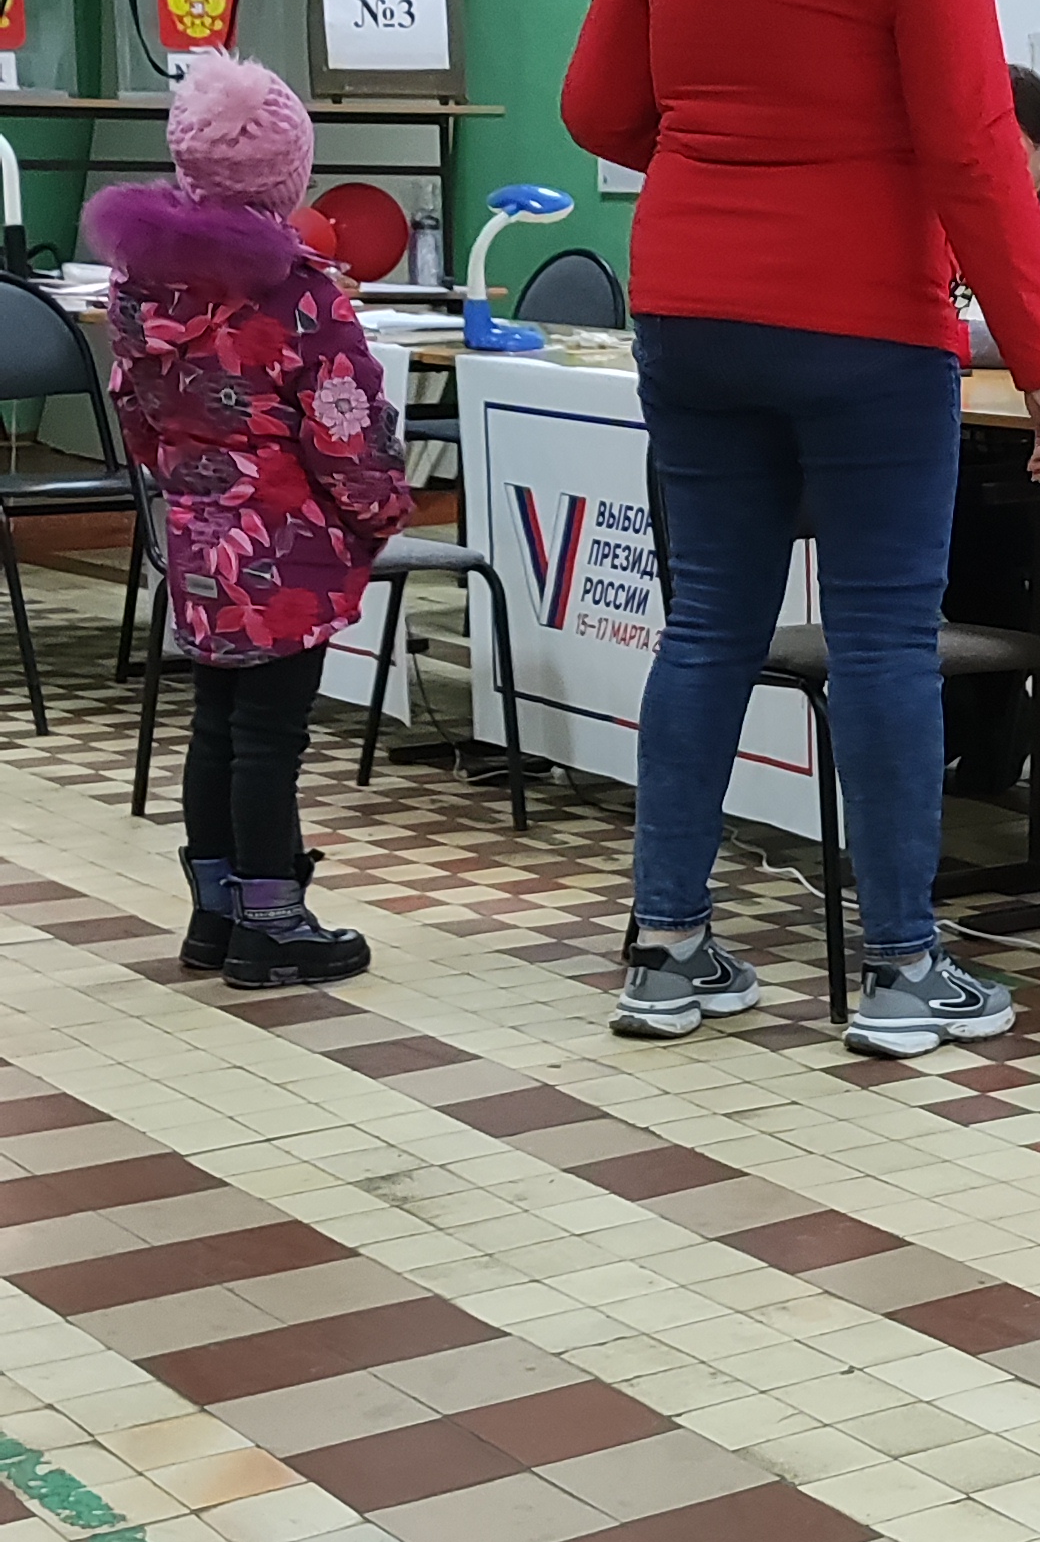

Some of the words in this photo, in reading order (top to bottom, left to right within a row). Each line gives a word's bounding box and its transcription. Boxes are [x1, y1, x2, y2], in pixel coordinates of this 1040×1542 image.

[587, 538, 659, 581] ПРЕЗИД
[580, 576, 651, 616] РОССИИ
[609, 620, 651, 652] МАРТА
